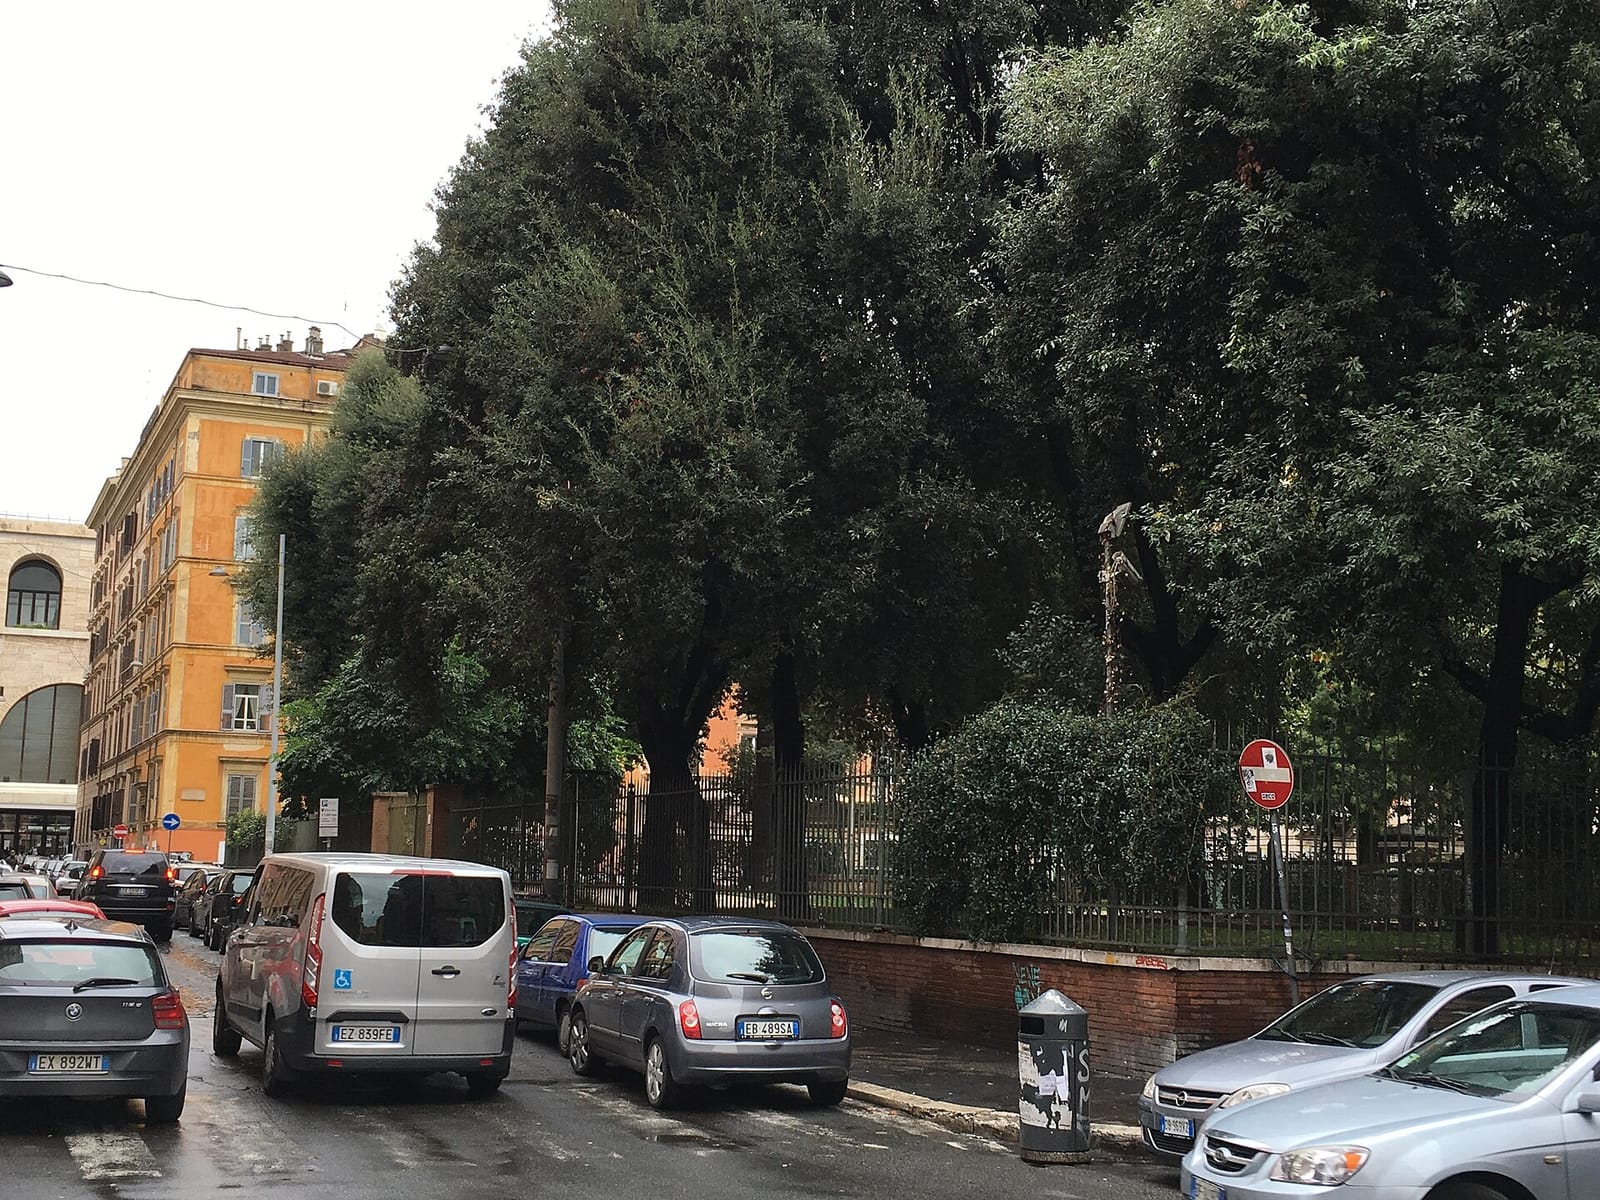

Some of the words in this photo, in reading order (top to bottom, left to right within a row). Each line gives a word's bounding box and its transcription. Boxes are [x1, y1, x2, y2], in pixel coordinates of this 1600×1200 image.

[341, 1028, 355, 1040] EZ
[358, 1028, 393, 1041] 839FE
[745, 1023, 758, 1034] EB
[762, 1022, 793, 1034] 489SA
[39, 1056, 55, 1070] EX
[60, 1056, 101, 1069] 892WT
